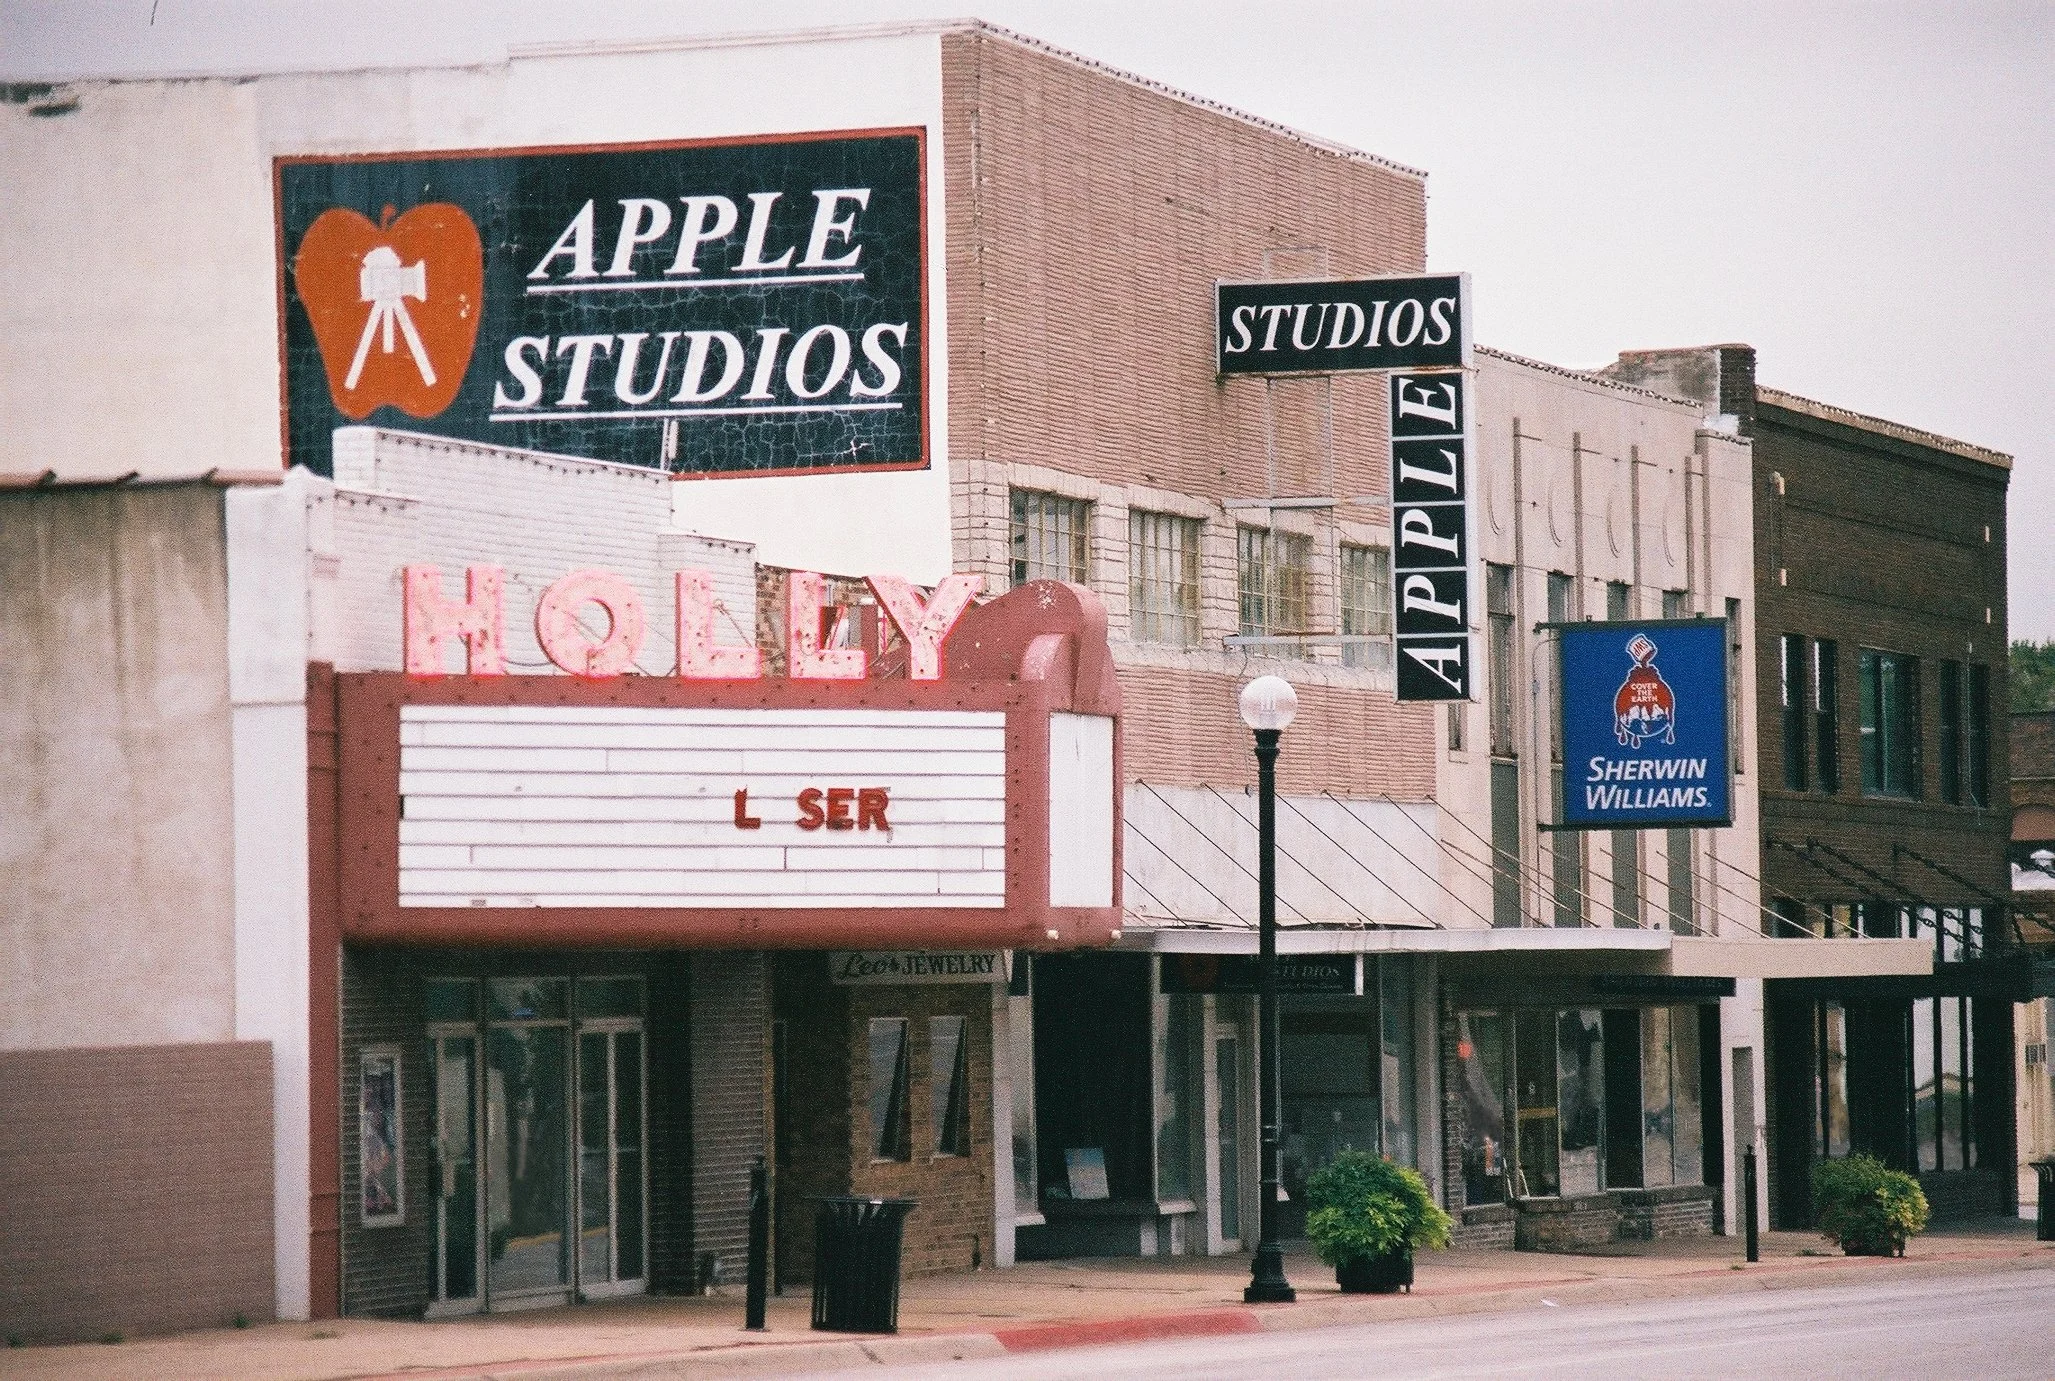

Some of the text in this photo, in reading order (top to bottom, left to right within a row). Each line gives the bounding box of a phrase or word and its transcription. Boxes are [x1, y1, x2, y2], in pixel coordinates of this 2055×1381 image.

[527, 188, 871, 279] APPLE
[1226, 297, 1456, 353] STUDIOS
[494, 322, 908, 409] STUDIOS
[1400, 379, 1462, 694] APPLE
[403, 564, 981, 681] HOLLY
[1586, 785, 1708, 810] WILLIAMS
[1587, 756, 1707, 782] SHERWIN
[903, 954, 995, 975] JEWELRY
